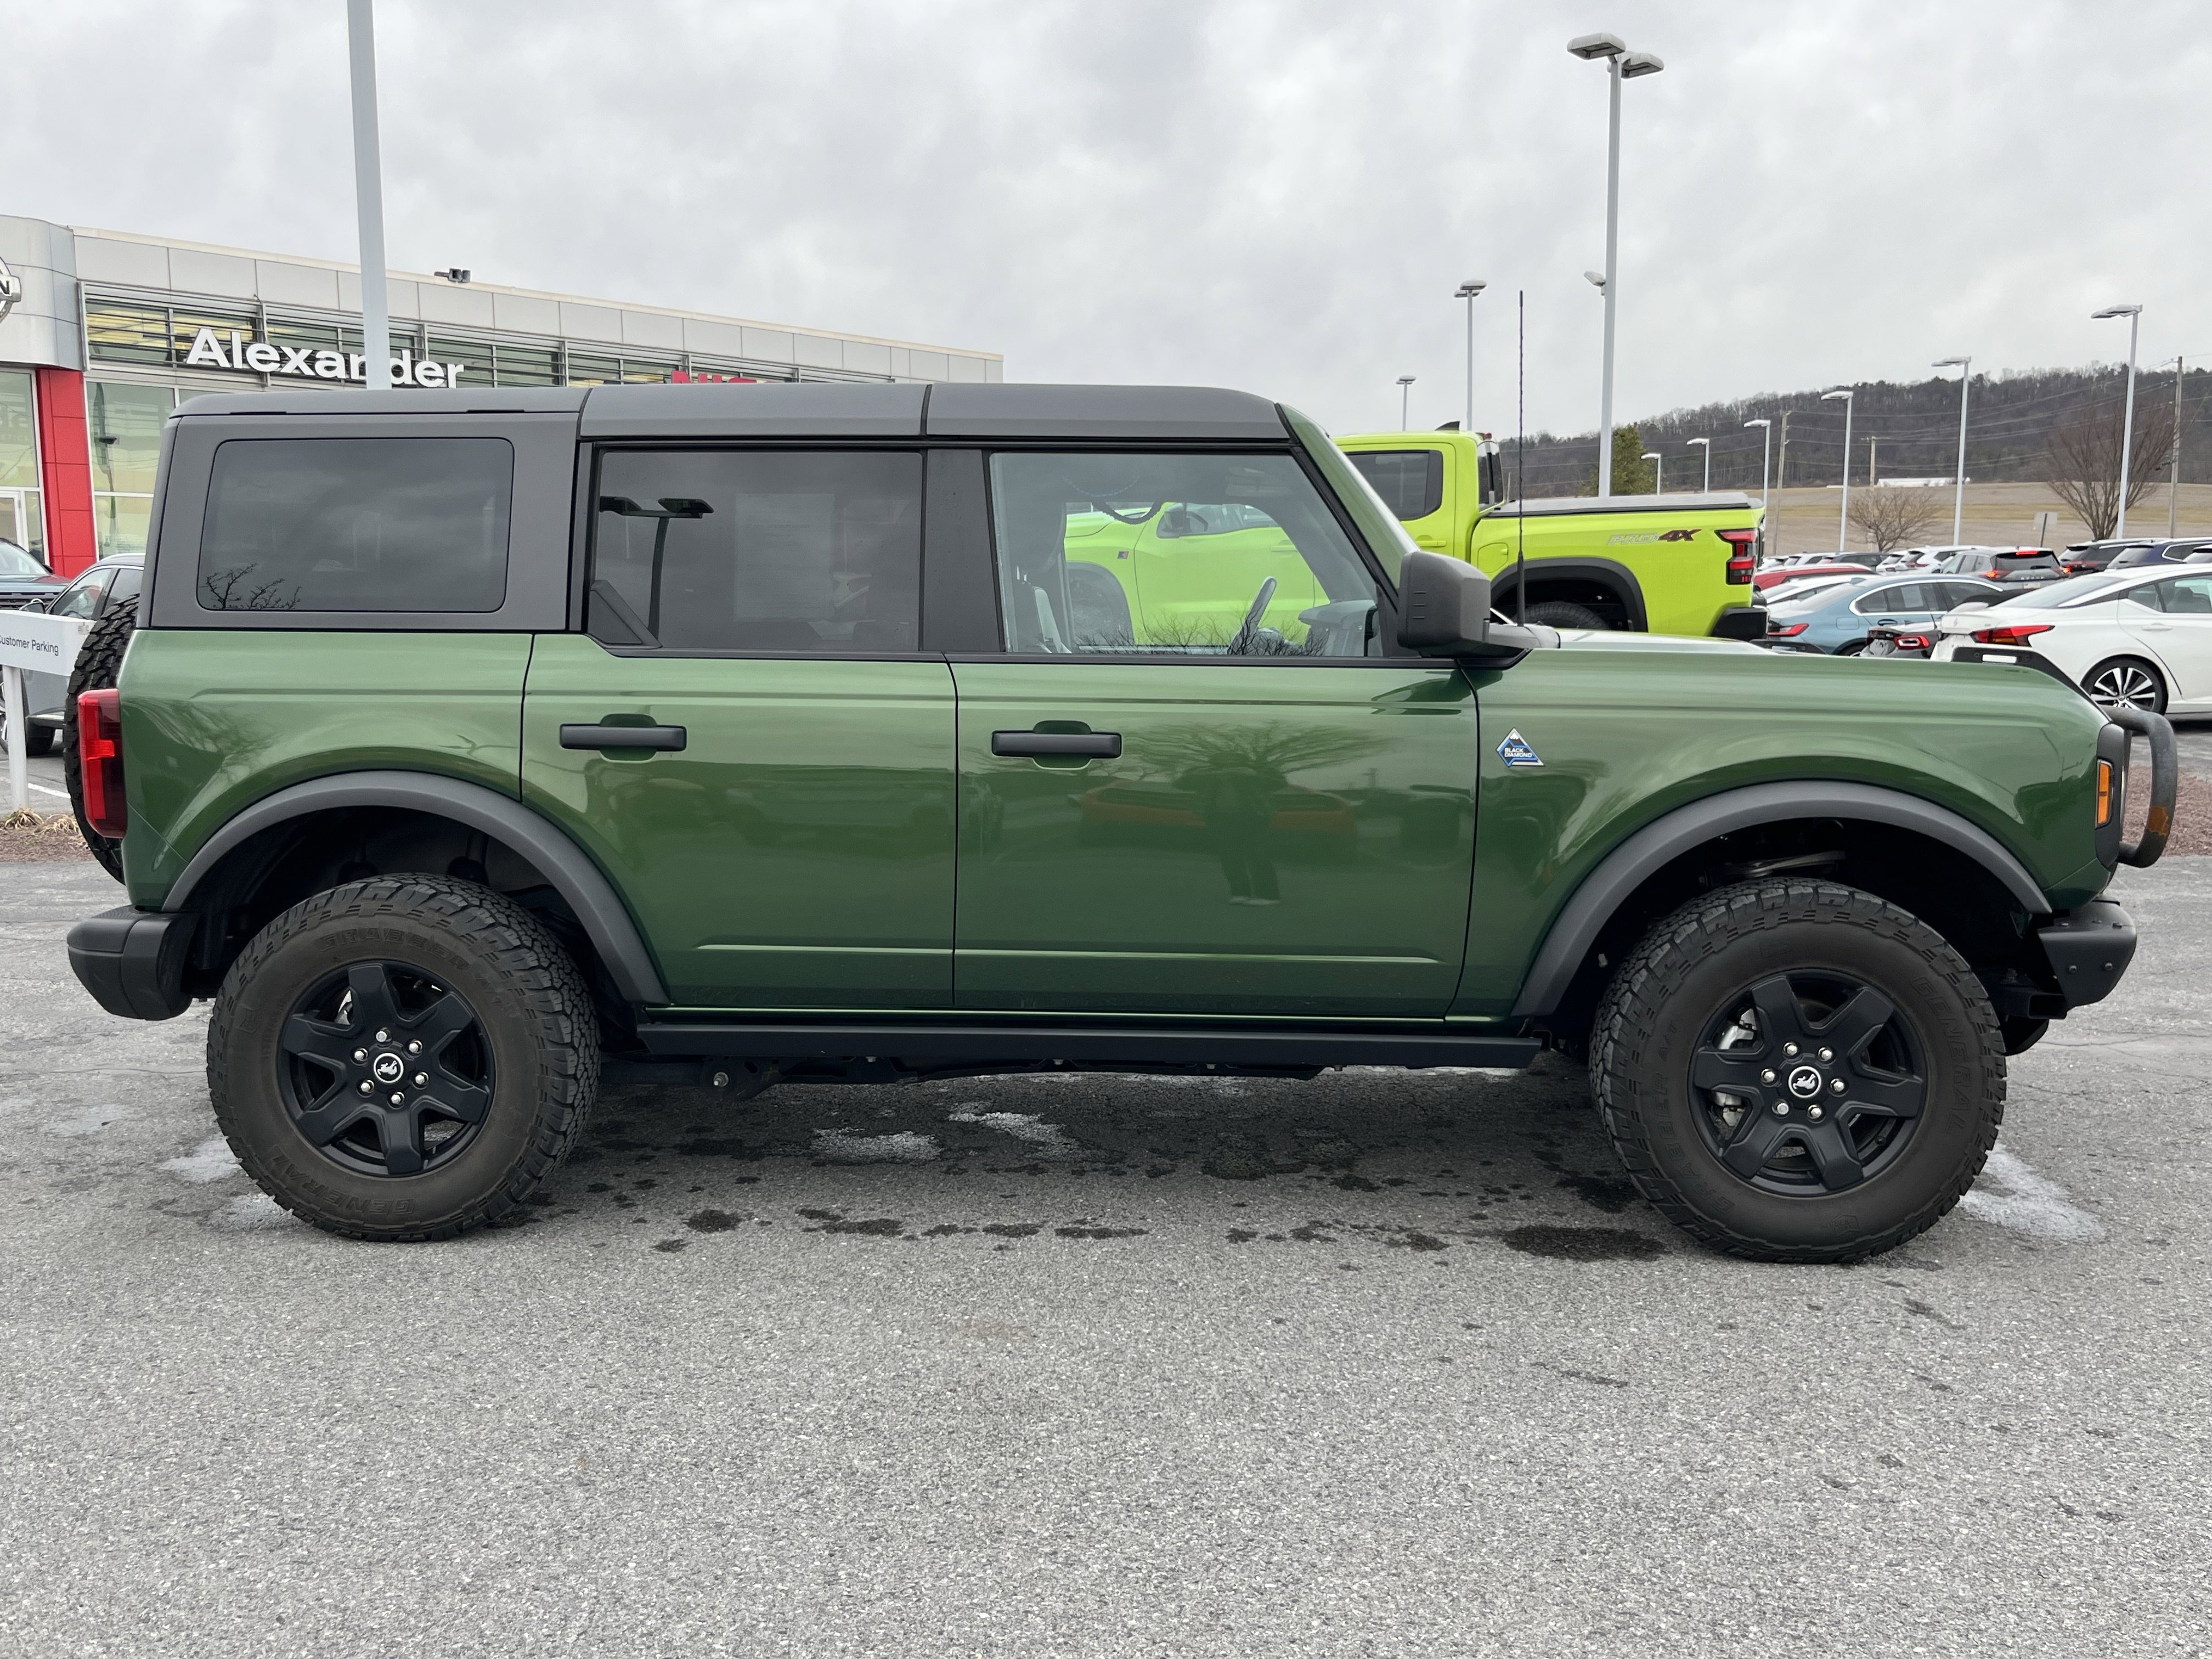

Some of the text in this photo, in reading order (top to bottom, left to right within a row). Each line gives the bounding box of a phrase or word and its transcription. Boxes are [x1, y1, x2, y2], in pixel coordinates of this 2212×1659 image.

[185, 328, 464, 389] Alexander
[31, 639, 59, 656] Parking
[1910, 977, 1970, 1134] GENERAL
[269, 1144, 415, 1215] GENERAL
